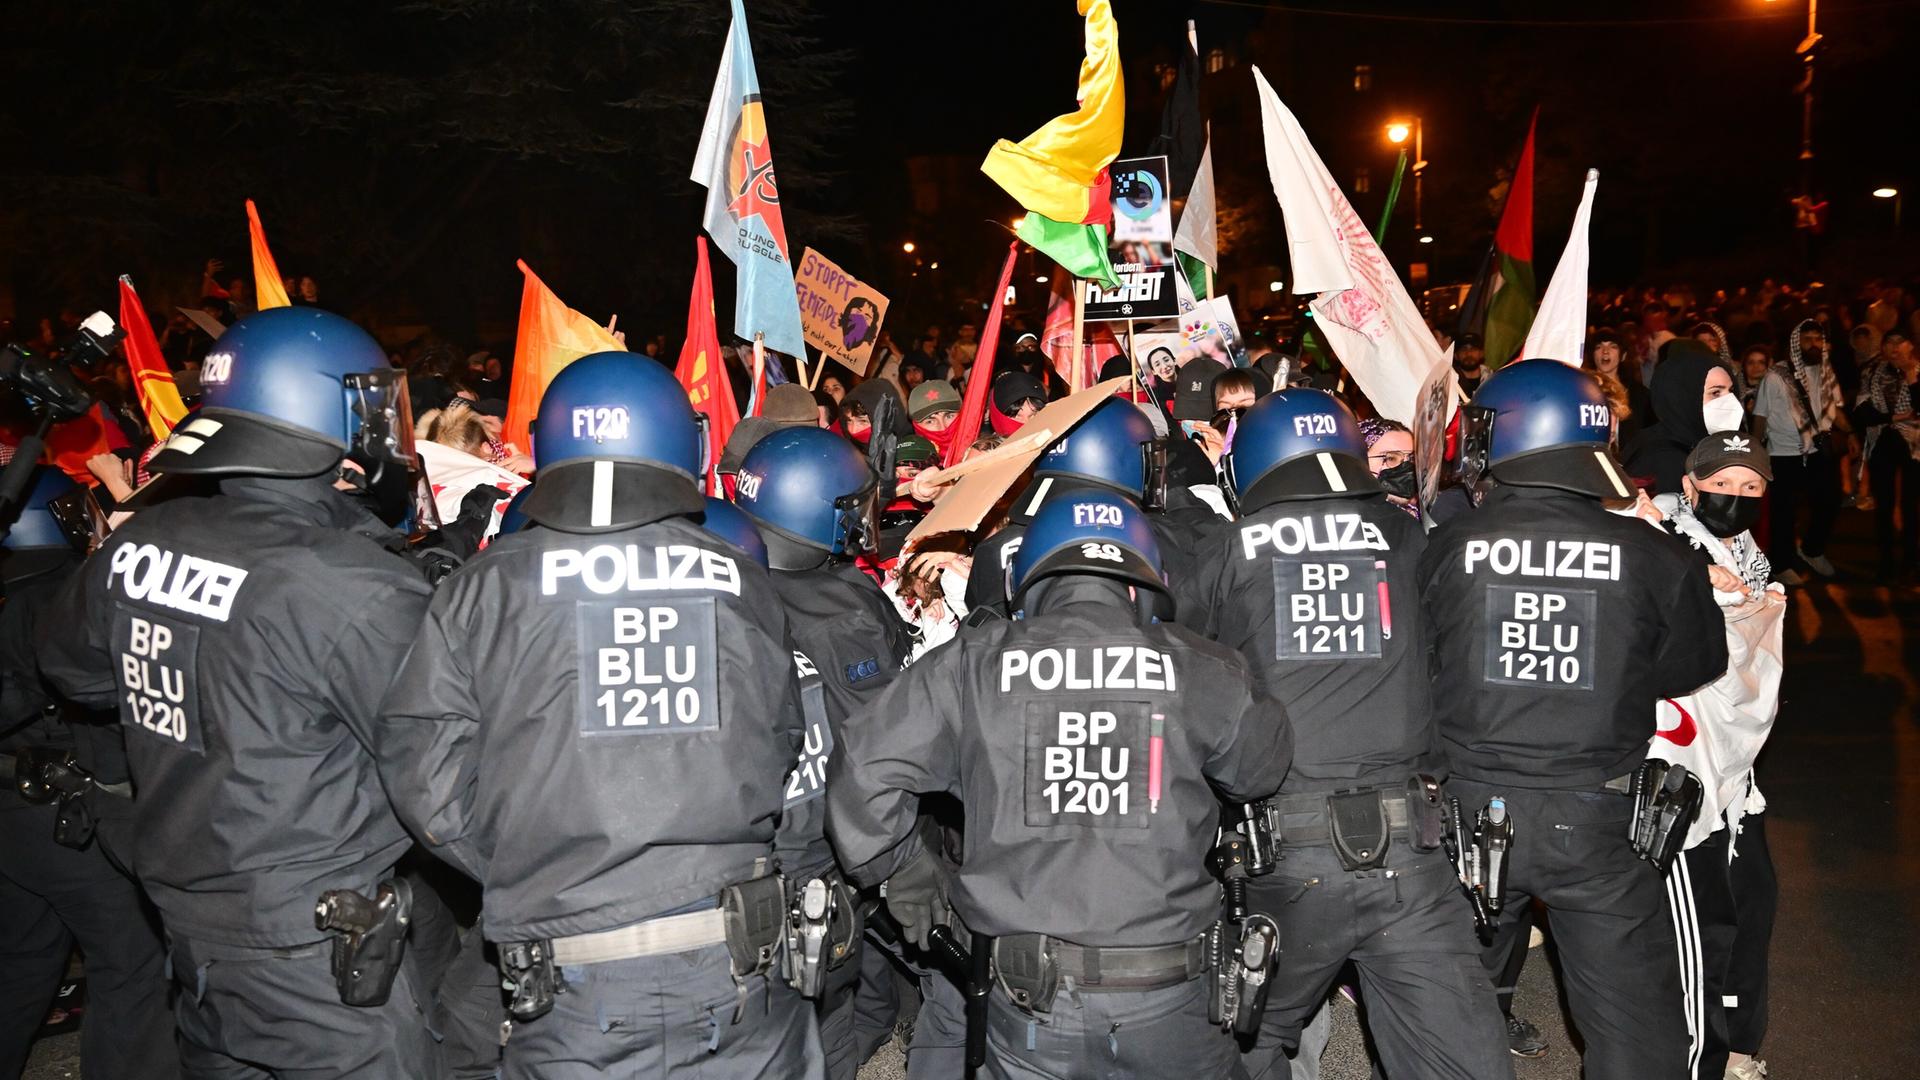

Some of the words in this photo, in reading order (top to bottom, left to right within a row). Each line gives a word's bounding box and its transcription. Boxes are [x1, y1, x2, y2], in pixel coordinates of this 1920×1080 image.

[738, 228, 776, 249] OUNG
[738, 237, 783, 263] RUGGLE
[803, 254, 858, 301] STOPPT
[573, 406, 628, 440] F120
[1294, 414, 1337, 437] F120
[1580, 404, 1609, 427] F120
[1073, 503, 1123, 527] F120
[1240, 513, 1391, 561] POLIZEI
[541, 543, 741, 598] POLIZEI
[1464, 538, 1621, 581] POLIZEI
[107, 541, 248, 623] POLIZEI
[1301, 563, 1350, 592] BP
[1290, 592, 1365, 623] BLU
[1514, 591, 1567, 622] BP
[130, 617, 173, 660] BP
[613, 606, 679, 645] BP
[1293, 624, 1365, 653] 1211
[1501, 620, 1579, 653] BLU
[122, 652, 185, 703] BLU
[598, 644, 696, 686] BLU
[1001, 645, 1176, 693] POLIZEI
[1499, 650, 1580, 684] 1210
[126, 691, 187, 742] 1220
[596, 686, 700, 727] 1210
[1057, 711, 1117, 746] BP
[786, 755, 829, 800] 210
[1044, 746, 1130, 781] BLU
[1042, 780, 1129, 816] 1201
